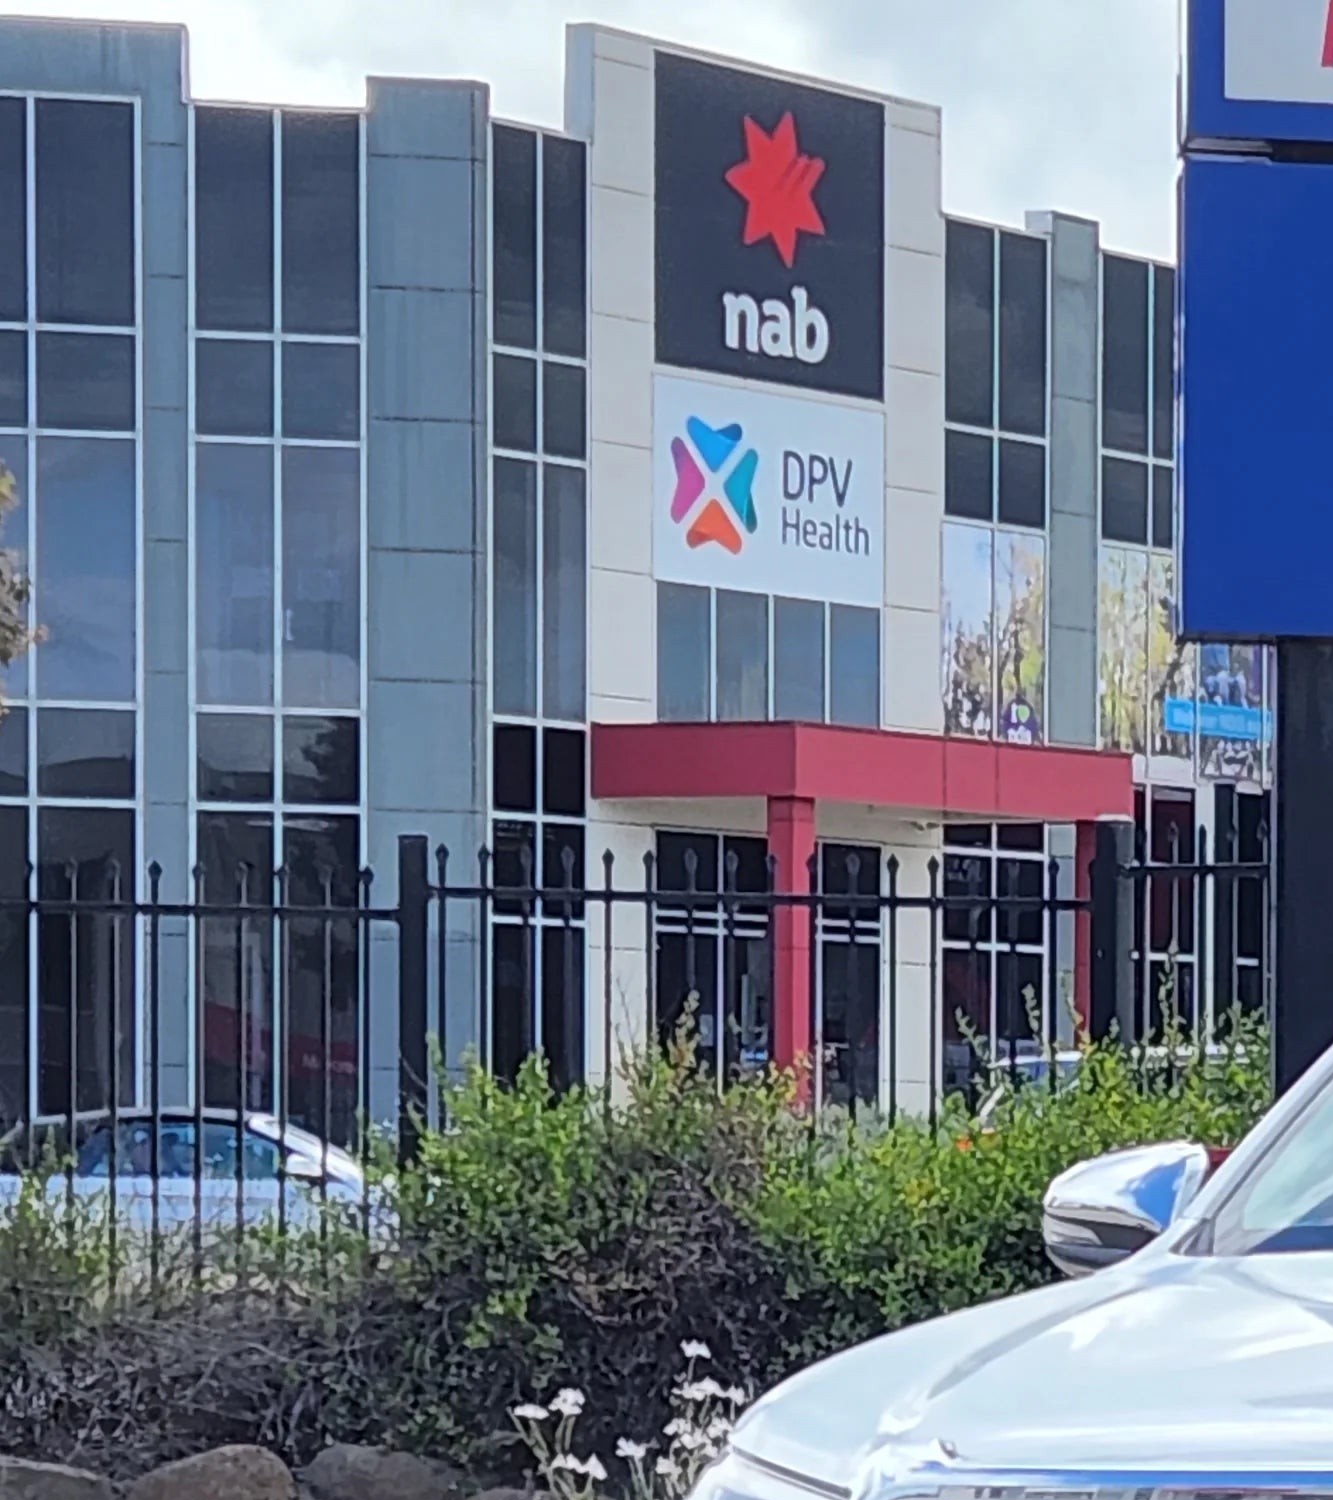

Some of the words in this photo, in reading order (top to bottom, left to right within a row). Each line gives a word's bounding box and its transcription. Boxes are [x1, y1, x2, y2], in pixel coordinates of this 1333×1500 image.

[722, 284, 829, 365] nab
[783, 450, 853, 508] DPV
[781, 506, 870, 556] Health
